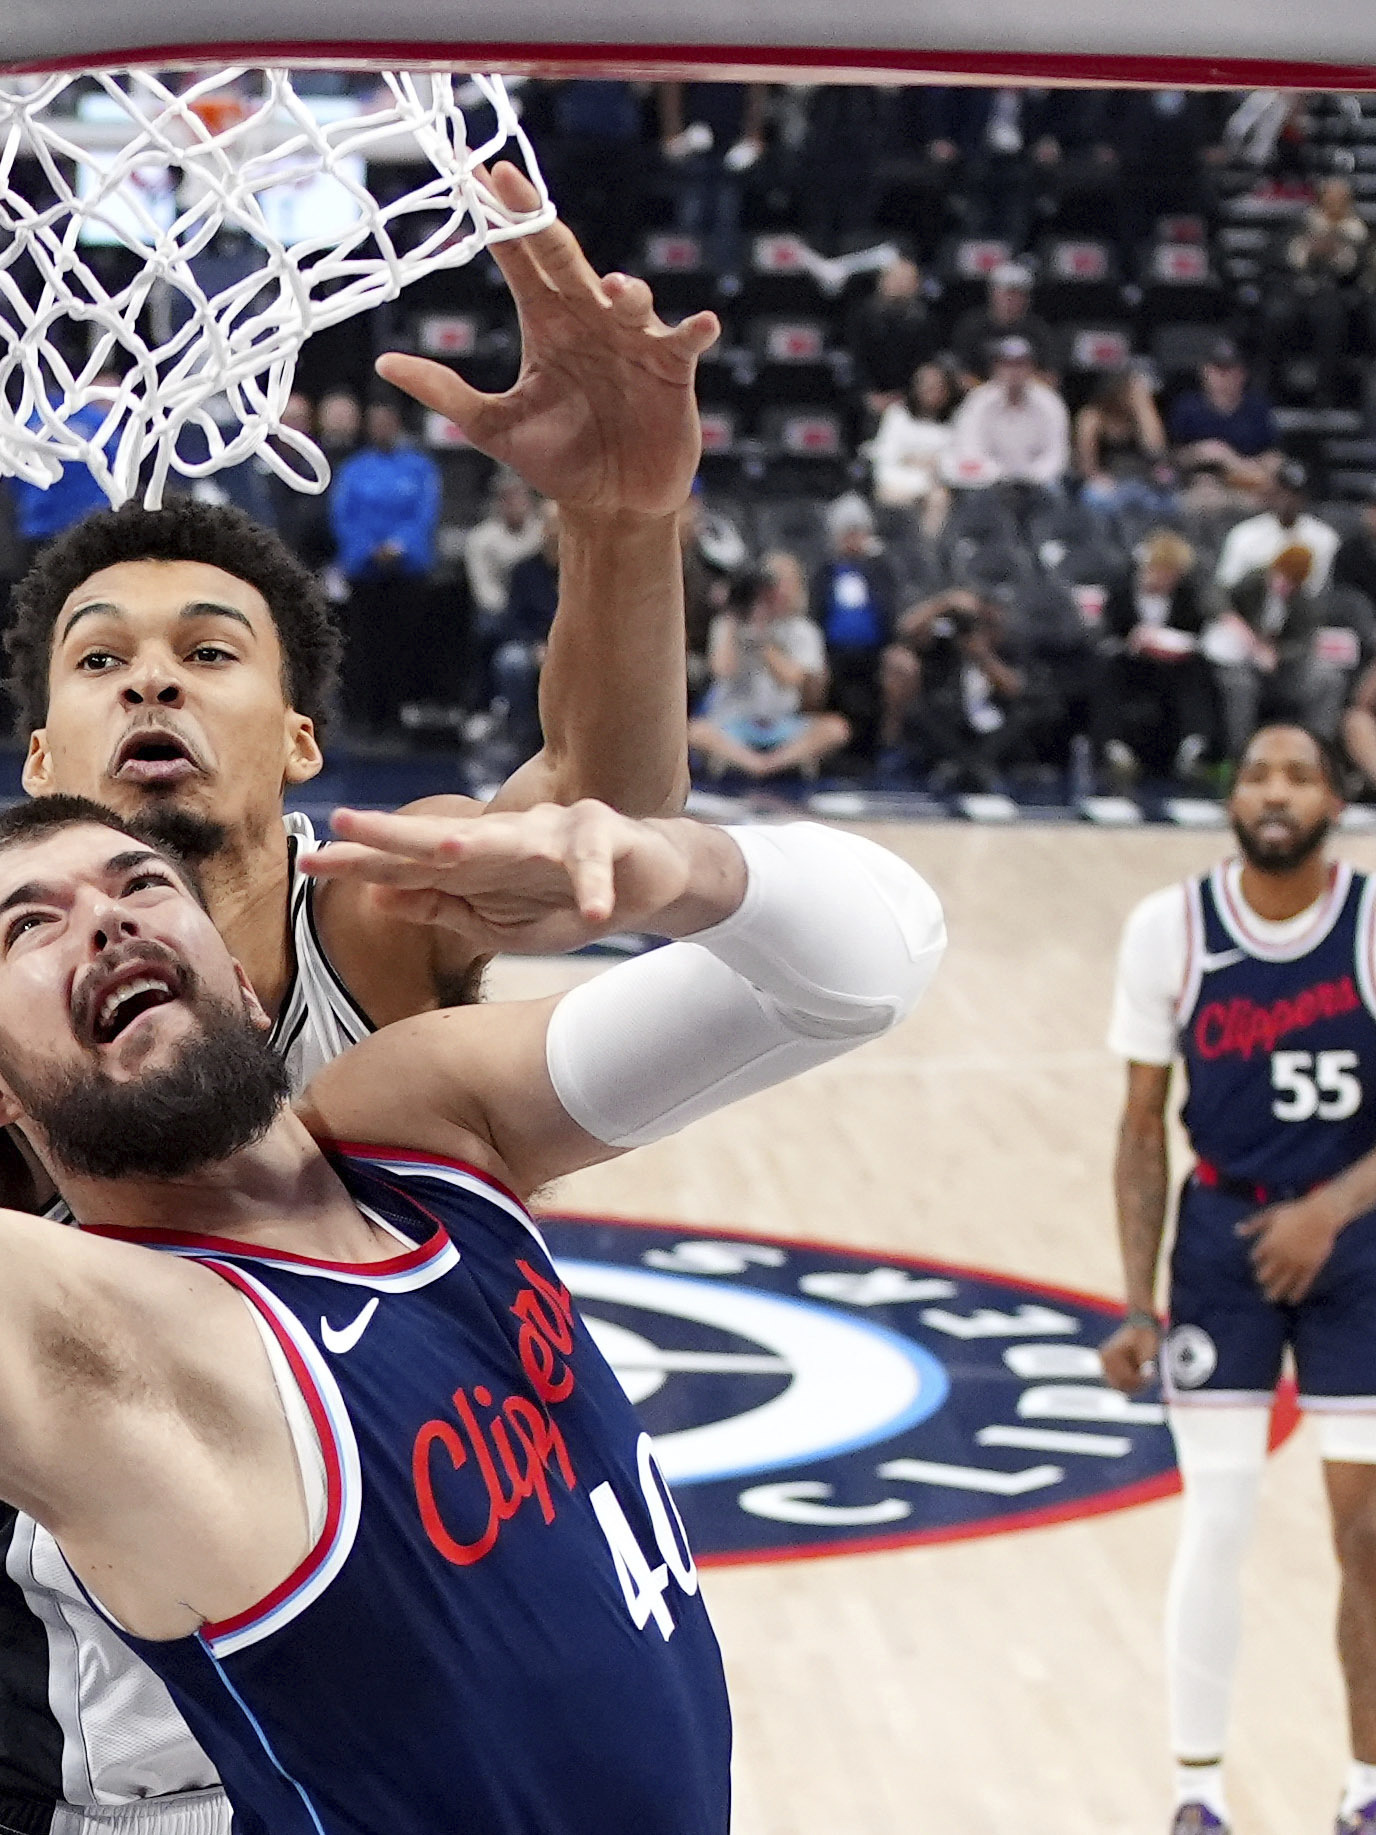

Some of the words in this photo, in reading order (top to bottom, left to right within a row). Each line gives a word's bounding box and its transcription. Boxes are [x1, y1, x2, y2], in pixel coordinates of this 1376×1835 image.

[1194, 975, 1360, 1062] Clippers
[1271, 1050, 1363, 1122] 55
[589, 1431, 698, 1642] 40
